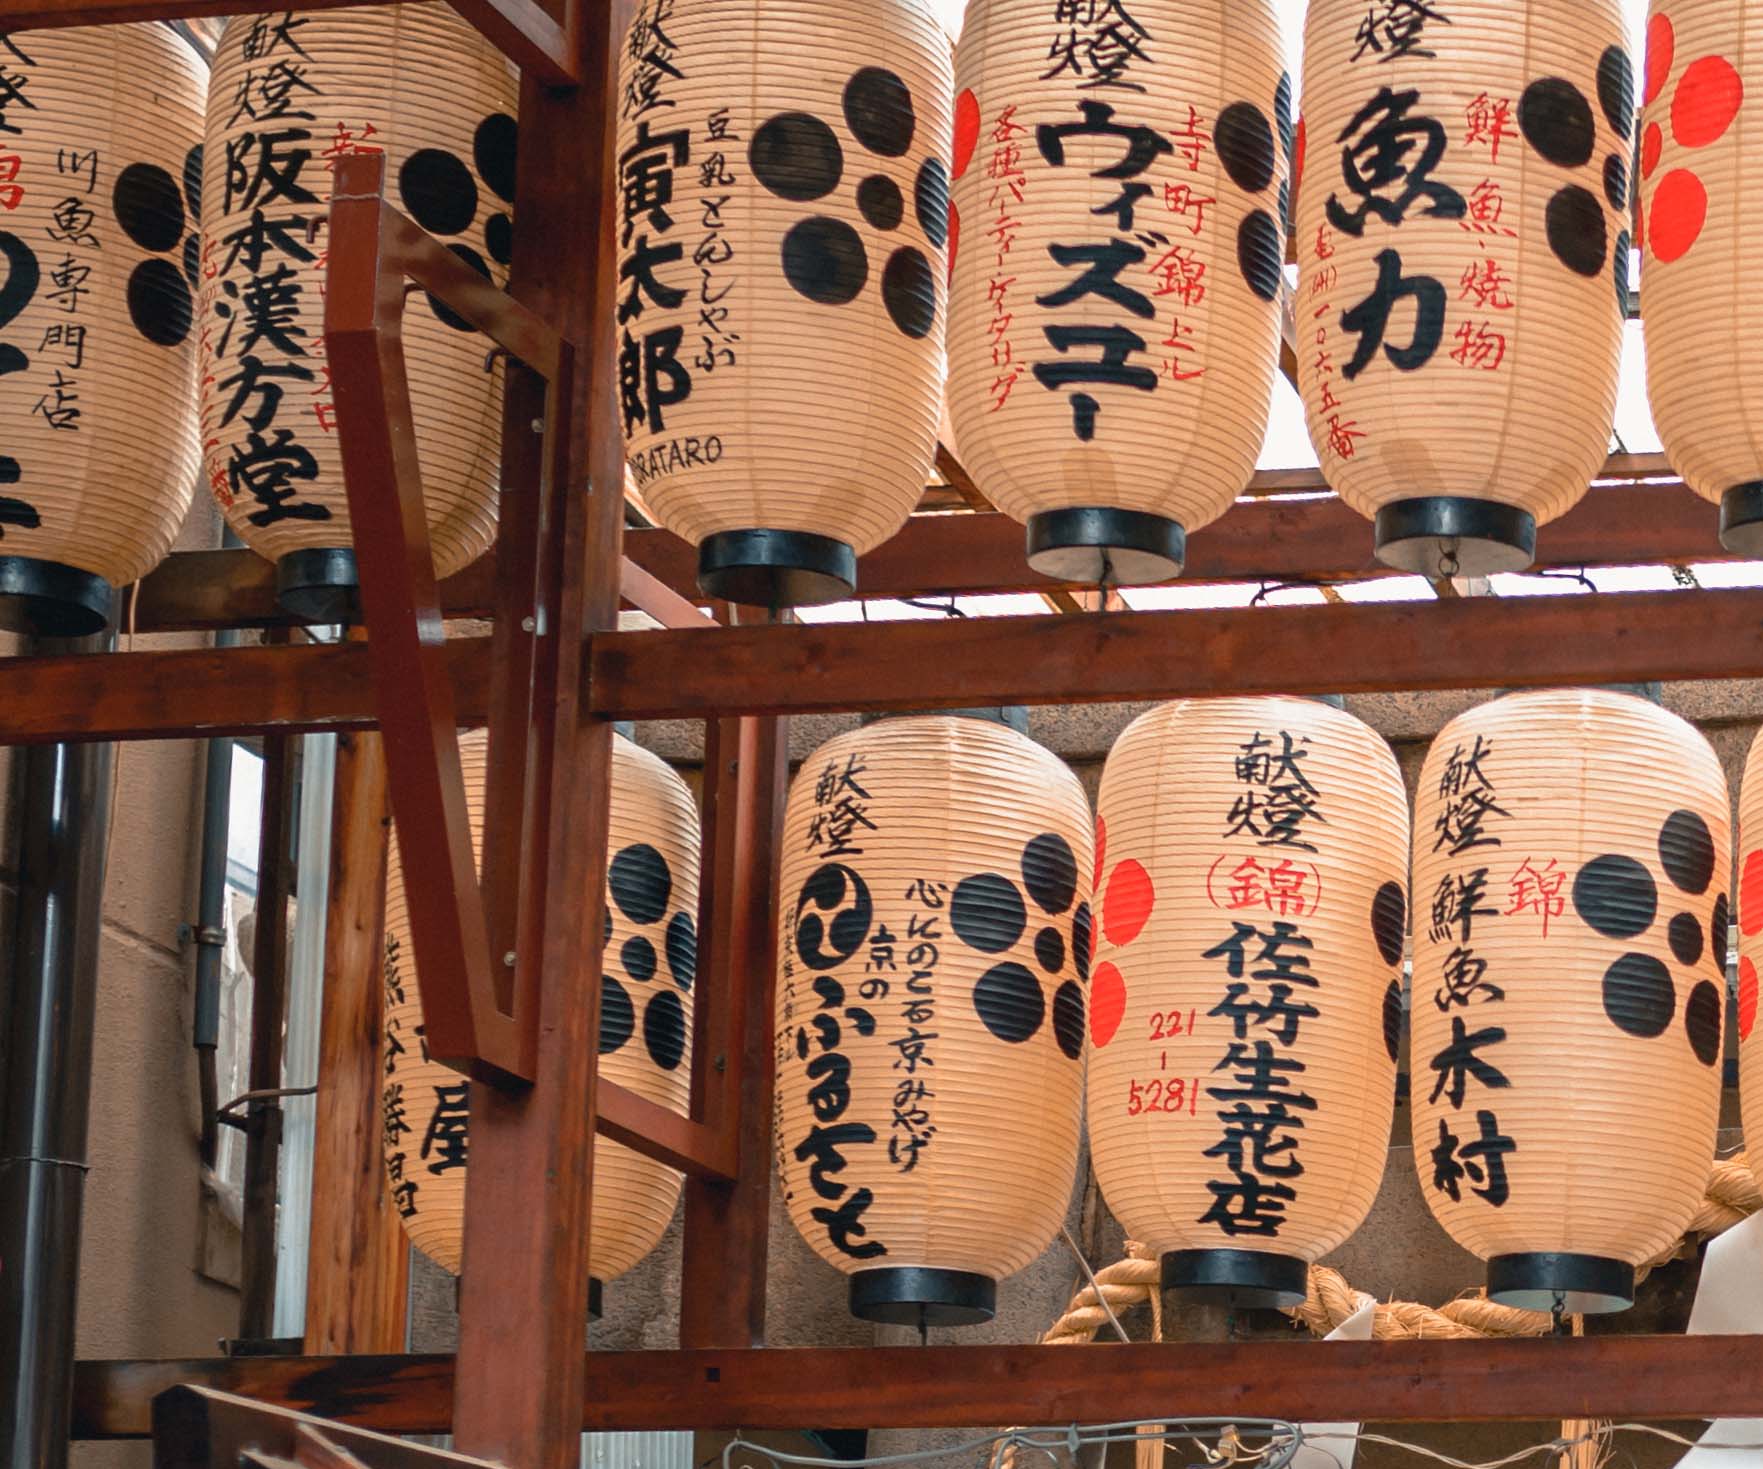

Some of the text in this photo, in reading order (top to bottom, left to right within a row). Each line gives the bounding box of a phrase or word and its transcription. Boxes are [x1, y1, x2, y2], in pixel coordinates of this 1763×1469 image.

[34, 148, 100, 431] 川魚専門店
[216, 128, 333, 528] 阪本漢方堂
[618, 122, 692, 439] 寅太郎
[693, 107, 742, 373] 豆乳とんしゃぶ
[1147, 105, 1217, 382] 寺町錦上ル
[1325, 86, 1469, 381] 魚力
[806, 752, 878, 860] 献燈
[1223, 729, 1328, 854] 献燈
[1433, 734, 1513, 858] 献燈
[1503, 855, 1568, 940] 錦
[794, 975, 888, 1259] ふるさと
[887, 877, 949, 1173] 心にのこる京みやげ
[1196, 921, 1321, 1239] 佐竹生花店
[1428, 865, 1517, 1209] 鮮魚木村
